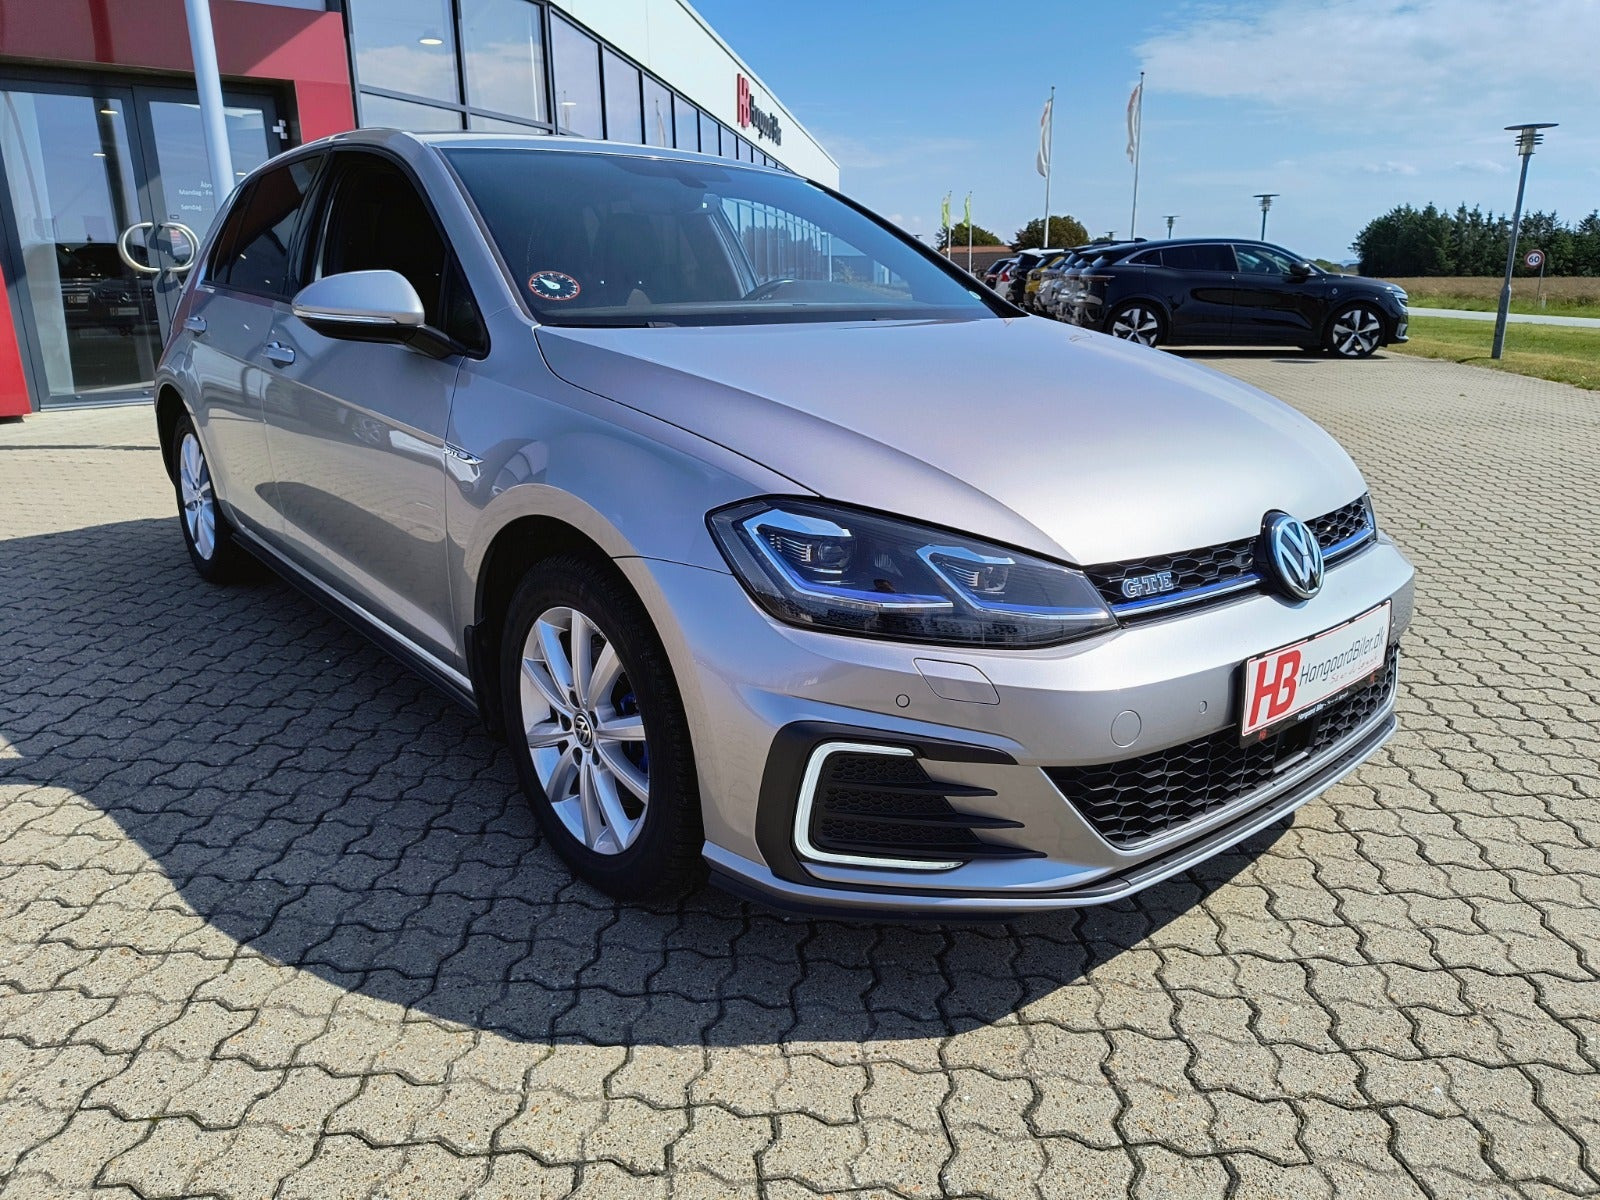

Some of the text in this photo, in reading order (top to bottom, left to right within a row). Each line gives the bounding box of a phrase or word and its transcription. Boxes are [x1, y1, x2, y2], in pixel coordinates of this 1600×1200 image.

[1529, 255, 1540, 263] 60
[1121, 570, 1175, 599] GTE
[1247, 649, 1302, 728] HB
